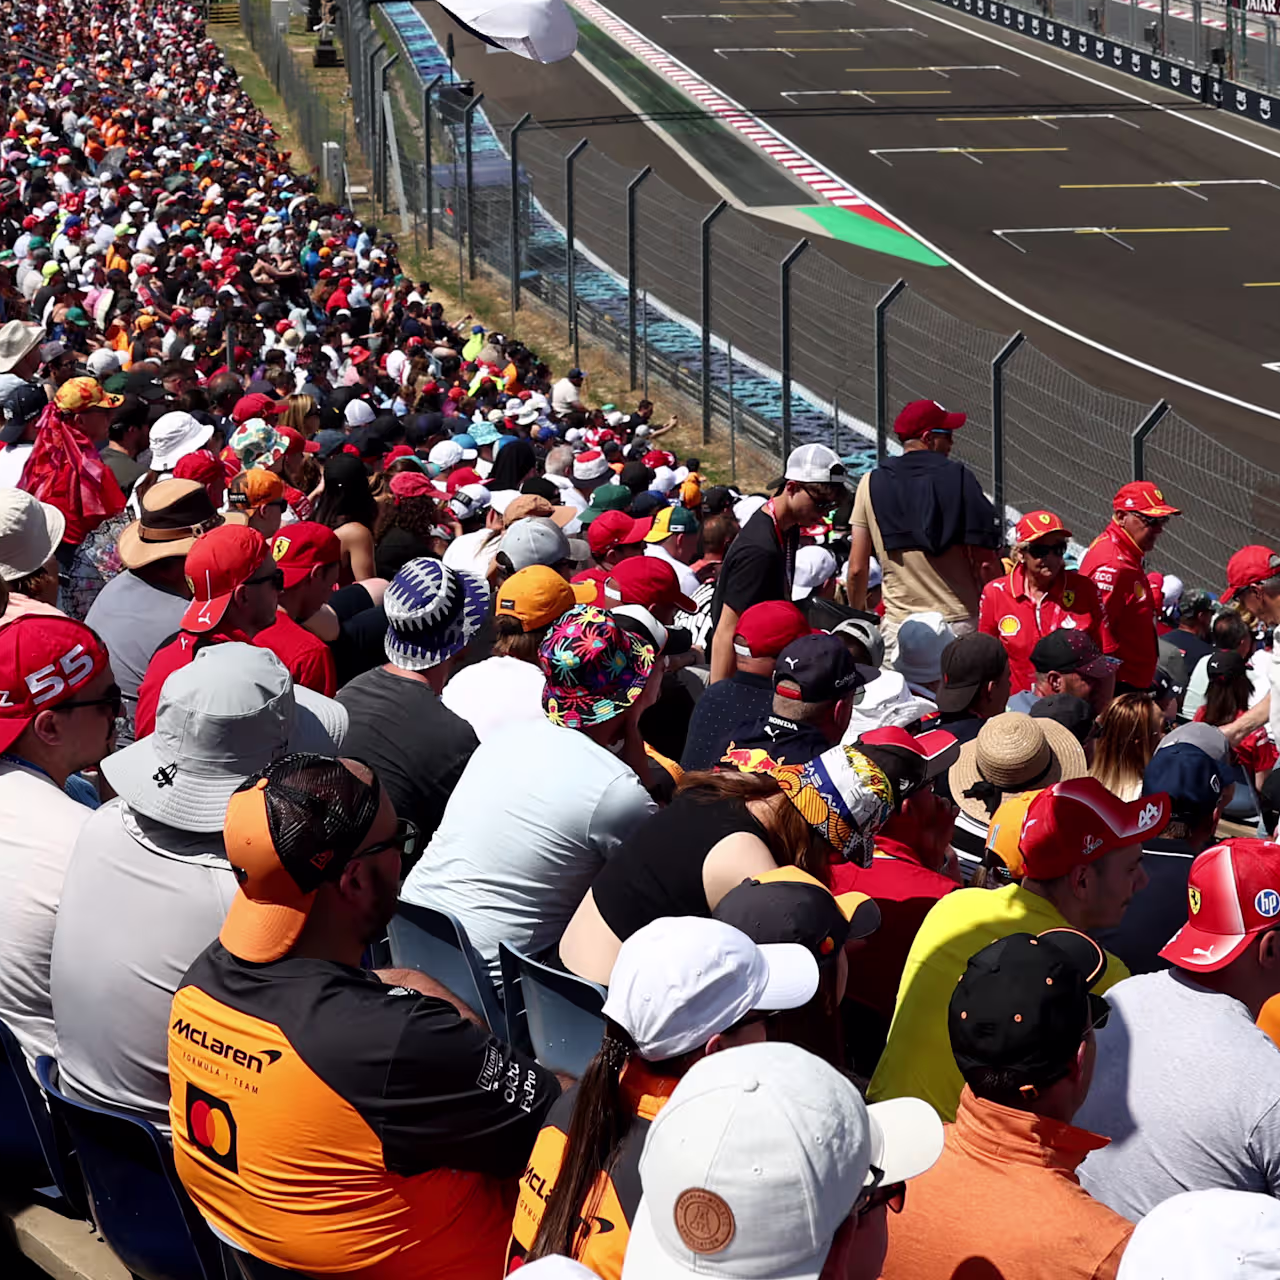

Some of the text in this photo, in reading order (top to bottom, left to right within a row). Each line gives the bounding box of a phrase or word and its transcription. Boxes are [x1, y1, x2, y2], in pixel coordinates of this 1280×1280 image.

[24, 643, 95, 705] 55
[769, 715, 799, 731] HONDA
[1137, 802, 1161, 828] 44
[1261, 891, 1277, 917] hp
[173, 1017, 264, 1074] McLaren
[183, 1051, 221, 1077] FORMULA
[234, 1076, 259, 1094] TEAM
[483, 1049, 498, 1086] Hilton
[504, 1062, 520, 1103] okta
[521, 1069, 537, 1114] FxPro
